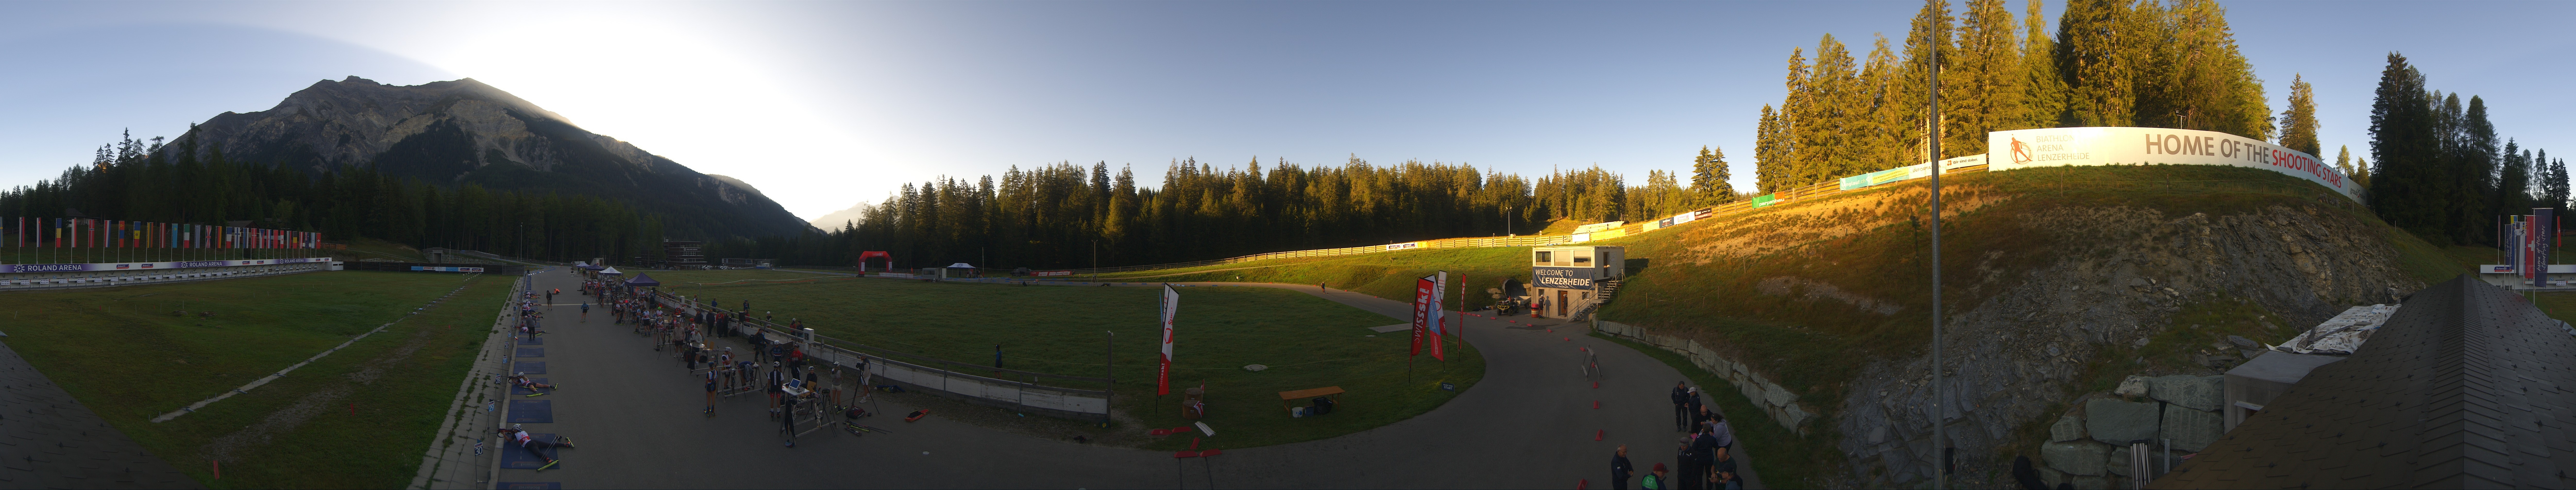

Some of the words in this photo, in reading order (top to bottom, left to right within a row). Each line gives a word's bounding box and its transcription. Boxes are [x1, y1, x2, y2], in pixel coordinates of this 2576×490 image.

[2146, 134, 2214, 156] HOME
[2221, 139, 2240, 159] OF
[2244, 143, 2269, 164] THE
[2273, 150, 2321, 177] SHOOTING
[2323, 167, 2341, 188] STARS
[1759, 198, 1784, 207] parpanbau
[1541, 277, 1590, 286] LENZERHEIDE
[475, 446, 483, 455] 30
